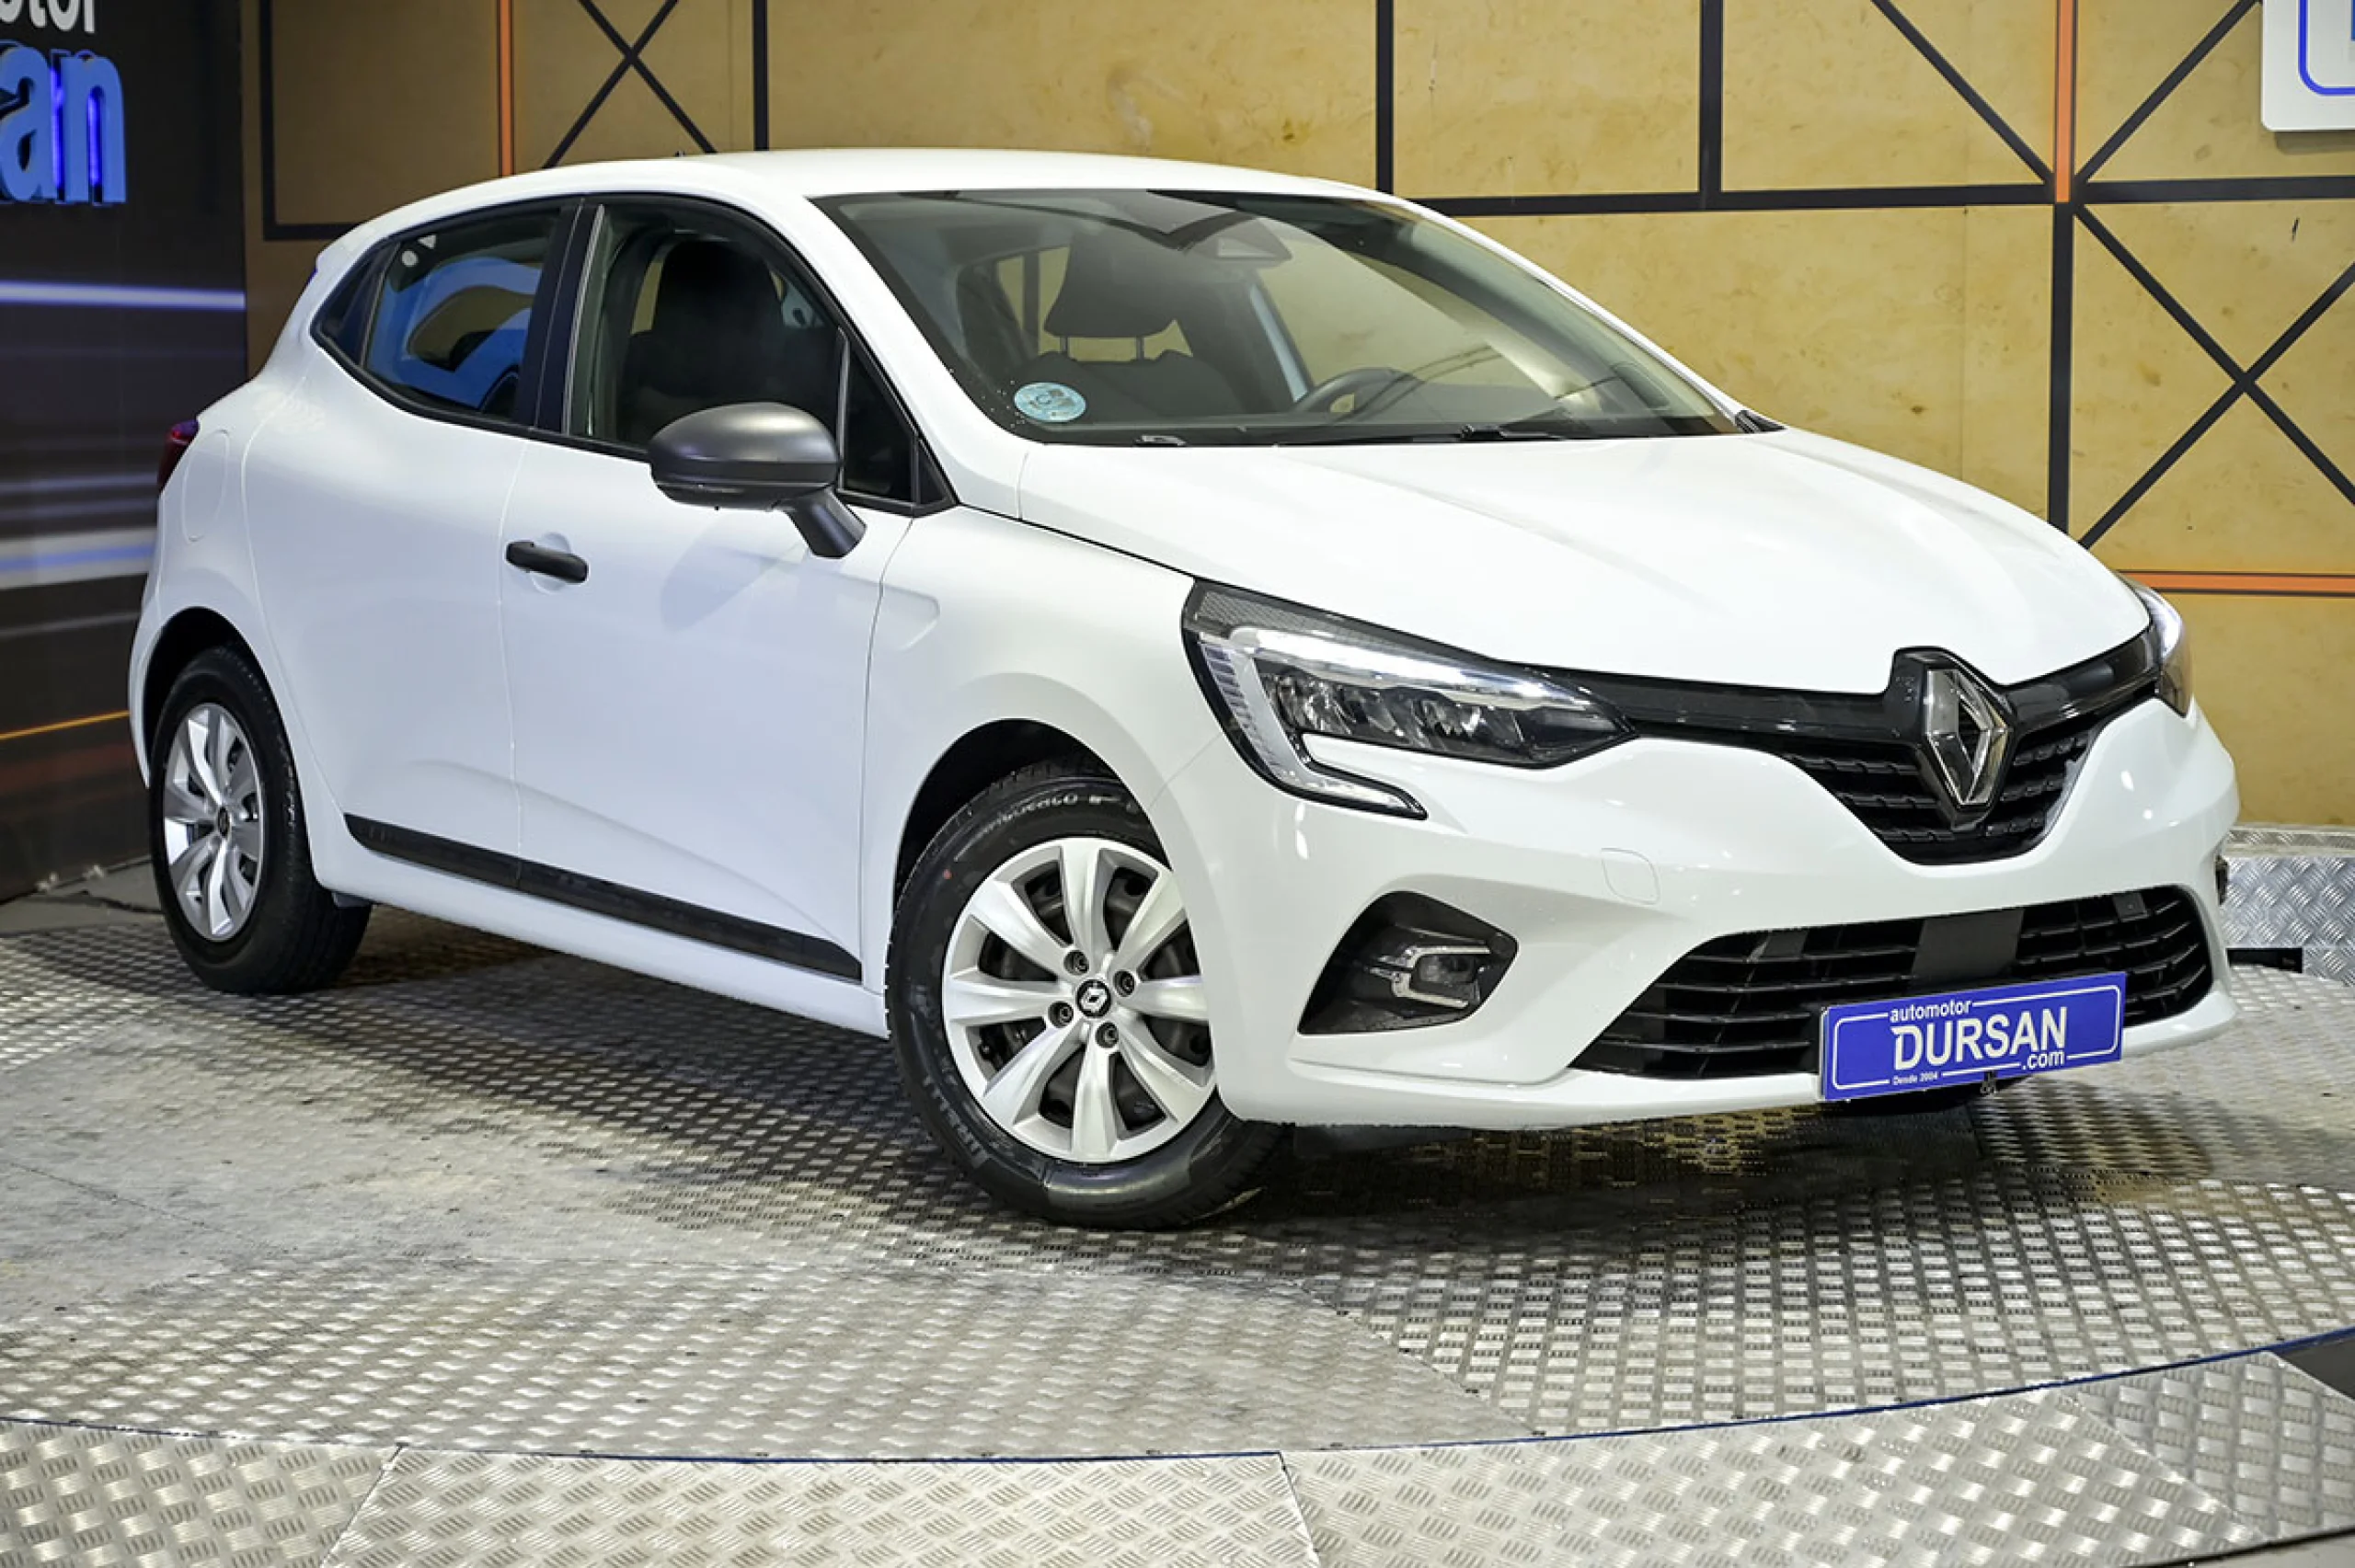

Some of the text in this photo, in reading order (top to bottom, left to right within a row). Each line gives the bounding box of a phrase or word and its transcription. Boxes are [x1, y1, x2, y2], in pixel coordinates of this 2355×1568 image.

[1890, 999, 1971, 1023] automotor
[1890, 1006, 2067, 1070] DURSAN
[2022, 1050, 2065, 1070] .com
